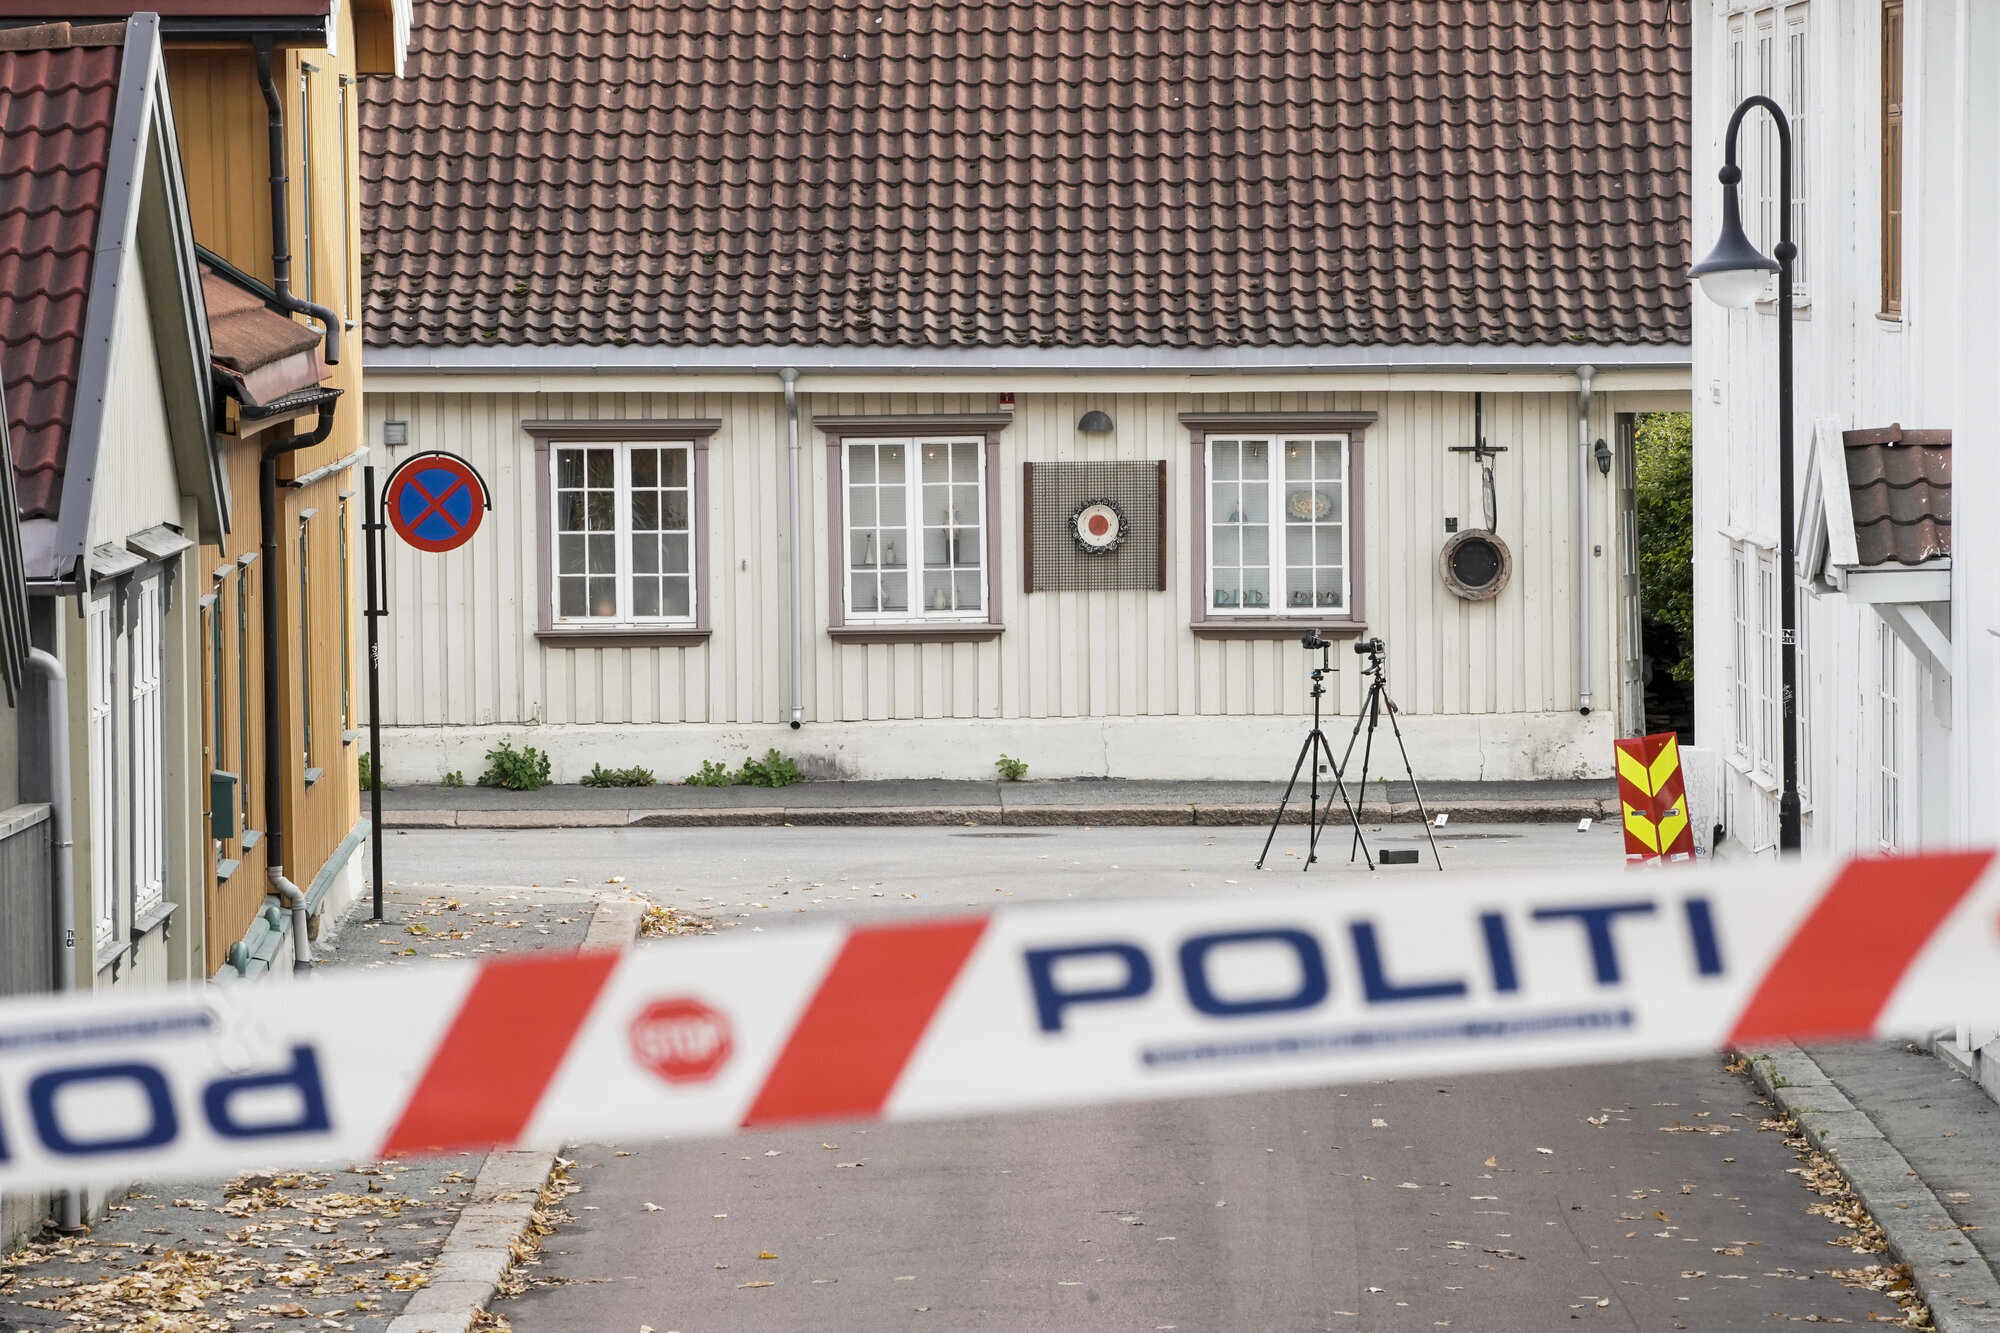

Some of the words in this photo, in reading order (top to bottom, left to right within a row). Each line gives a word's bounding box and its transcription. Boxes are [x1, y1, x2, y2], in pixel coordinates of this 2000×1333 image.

[1026, 899, 1723, 1033] POLITI
[642, 1019, 718, 1059] STOP
[0, 1045, 331, 1163] PO
